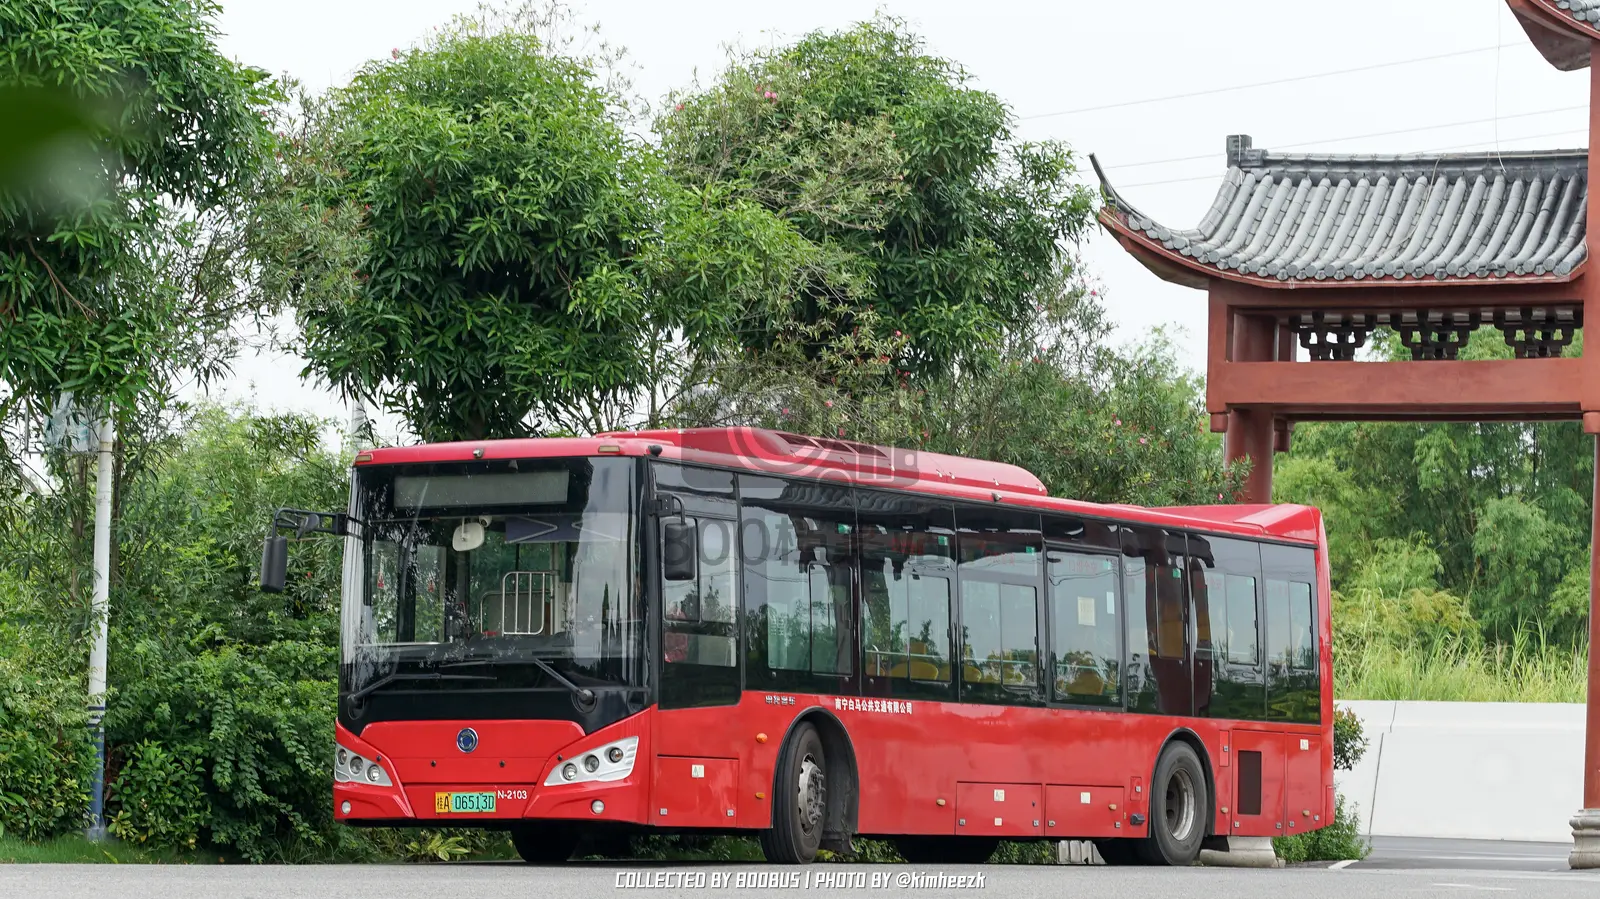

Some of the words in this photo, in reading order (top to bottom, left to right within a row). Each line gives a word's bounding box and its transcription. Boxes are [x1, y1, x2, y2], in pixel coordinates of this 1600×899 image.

[835, 697, 913, 715] 南宁白马公共交通有限公司
[497, 789, 527, 800] N-2103
